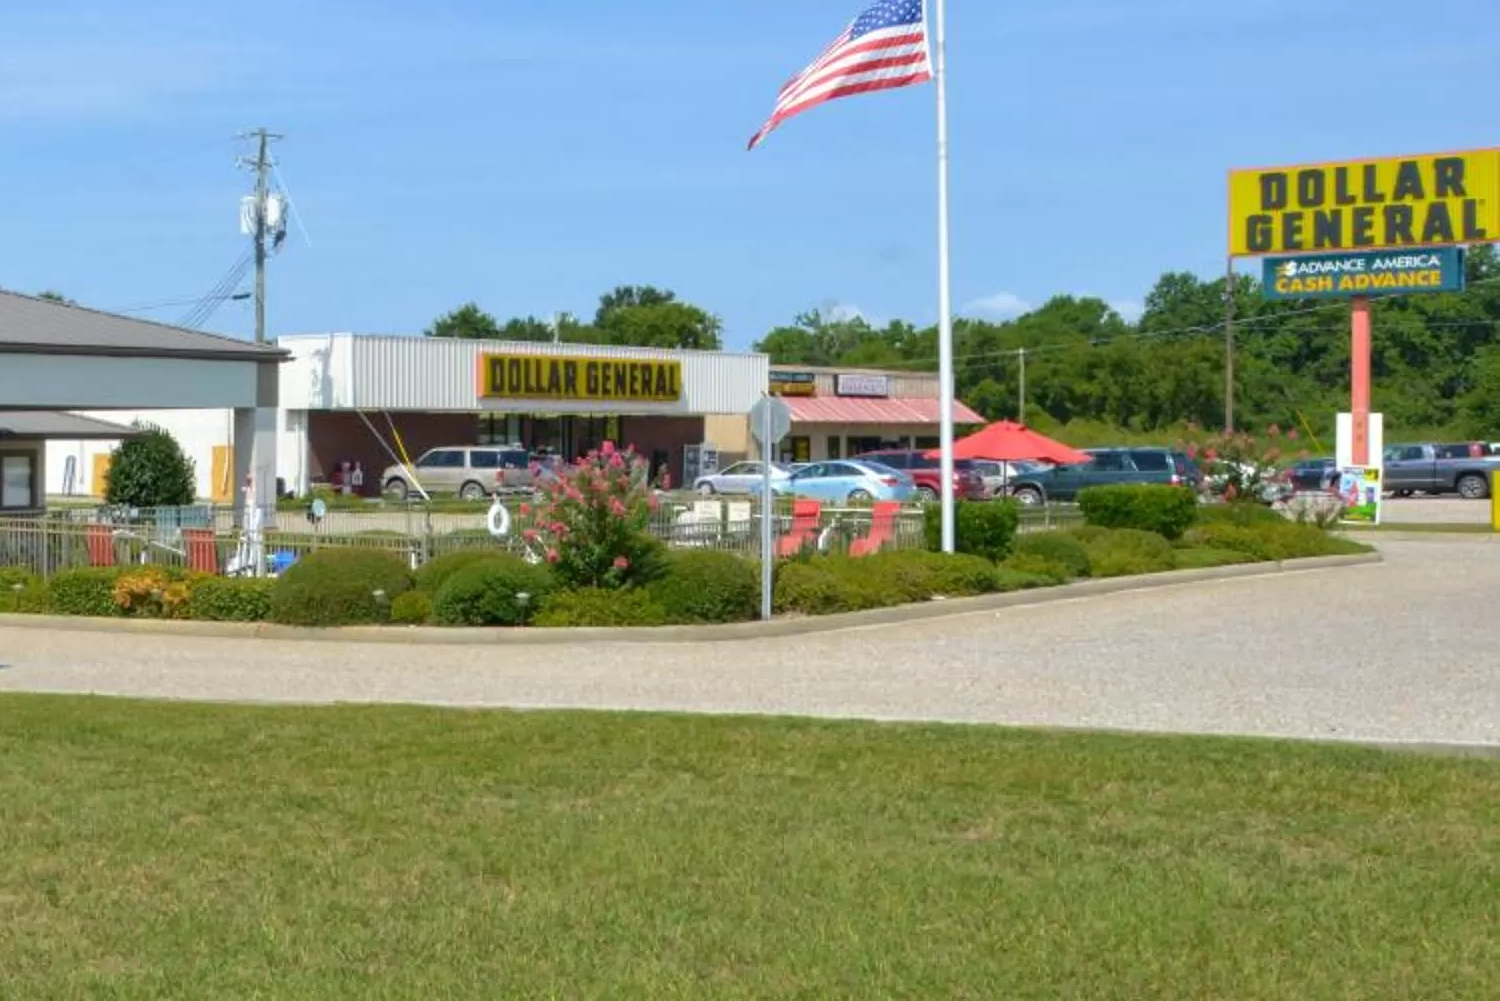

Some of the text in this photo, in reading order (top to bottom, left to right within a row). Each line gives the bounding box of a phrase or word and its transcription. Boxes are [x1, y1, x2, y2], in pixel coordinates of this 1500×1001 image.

[1260, 157, 1467, 210] DOLLAR
[1246, 199, 1486, 252] GENERAL
[1275, 270, 1442, 294] CASH ADVANCE
[1298, 254, 1441, 274] ADVANCE AMERICA
[490, 357, 679, 396] DOLLAR GENERAL
